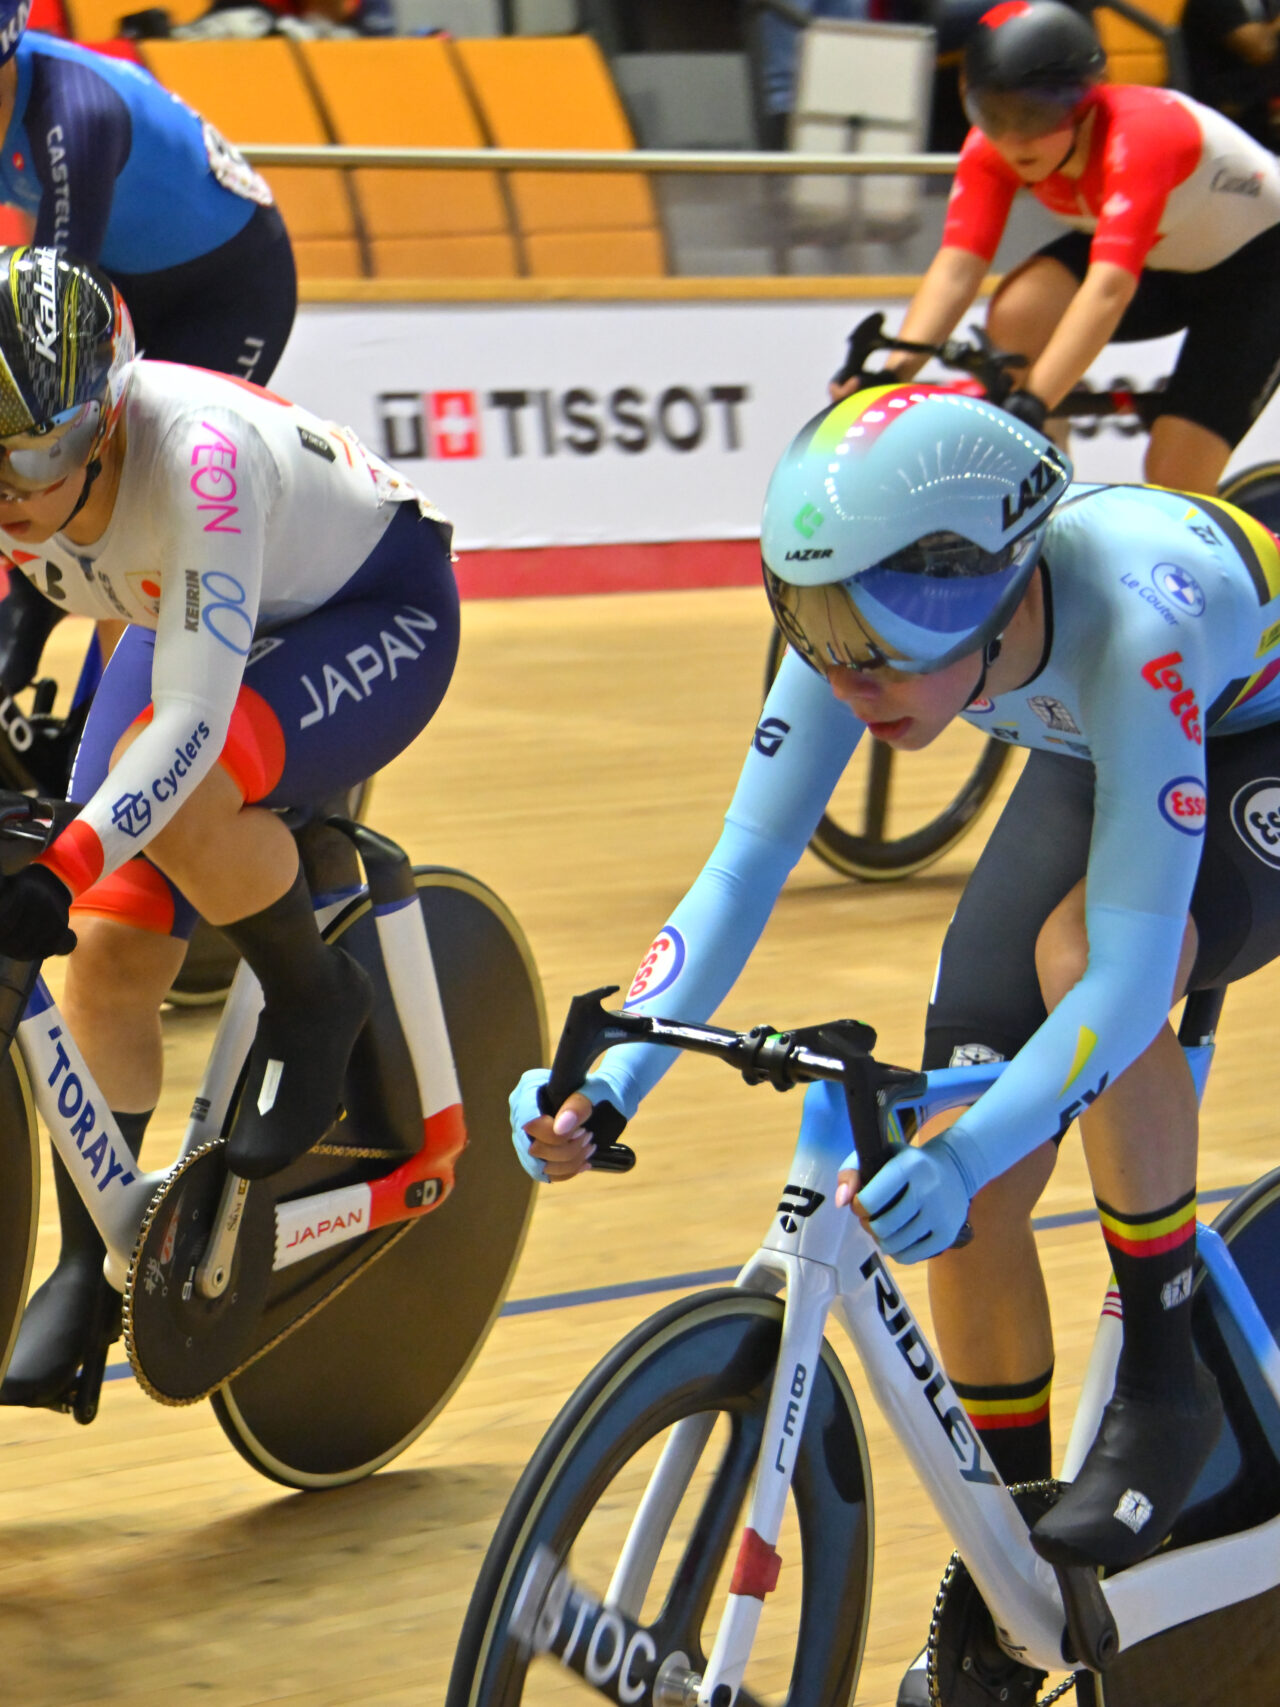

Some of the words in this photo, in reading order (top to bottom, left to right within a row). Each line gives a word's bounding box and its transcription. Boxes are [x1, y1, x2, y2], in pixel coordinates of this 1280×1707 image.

[34, 245, 60, 364] Kabut
[488, 385, 750, 459] TISSOT
[1001, 445, 1067, 532] LAZ
[784, 548, 833, 561] LAZER
[184, 569, 201, 633] KEIRIN
[300, 606, 438, 730] JAPAN
[1140, 651, 1203, 746] Lotto
[151, 720, 211, 803] Cyclers
[285, 1208, 363, 1249] JAPAN
[859, 1250, 1002, 1486] RIDLEY
[775, 1363, 807, 1474] BEL
